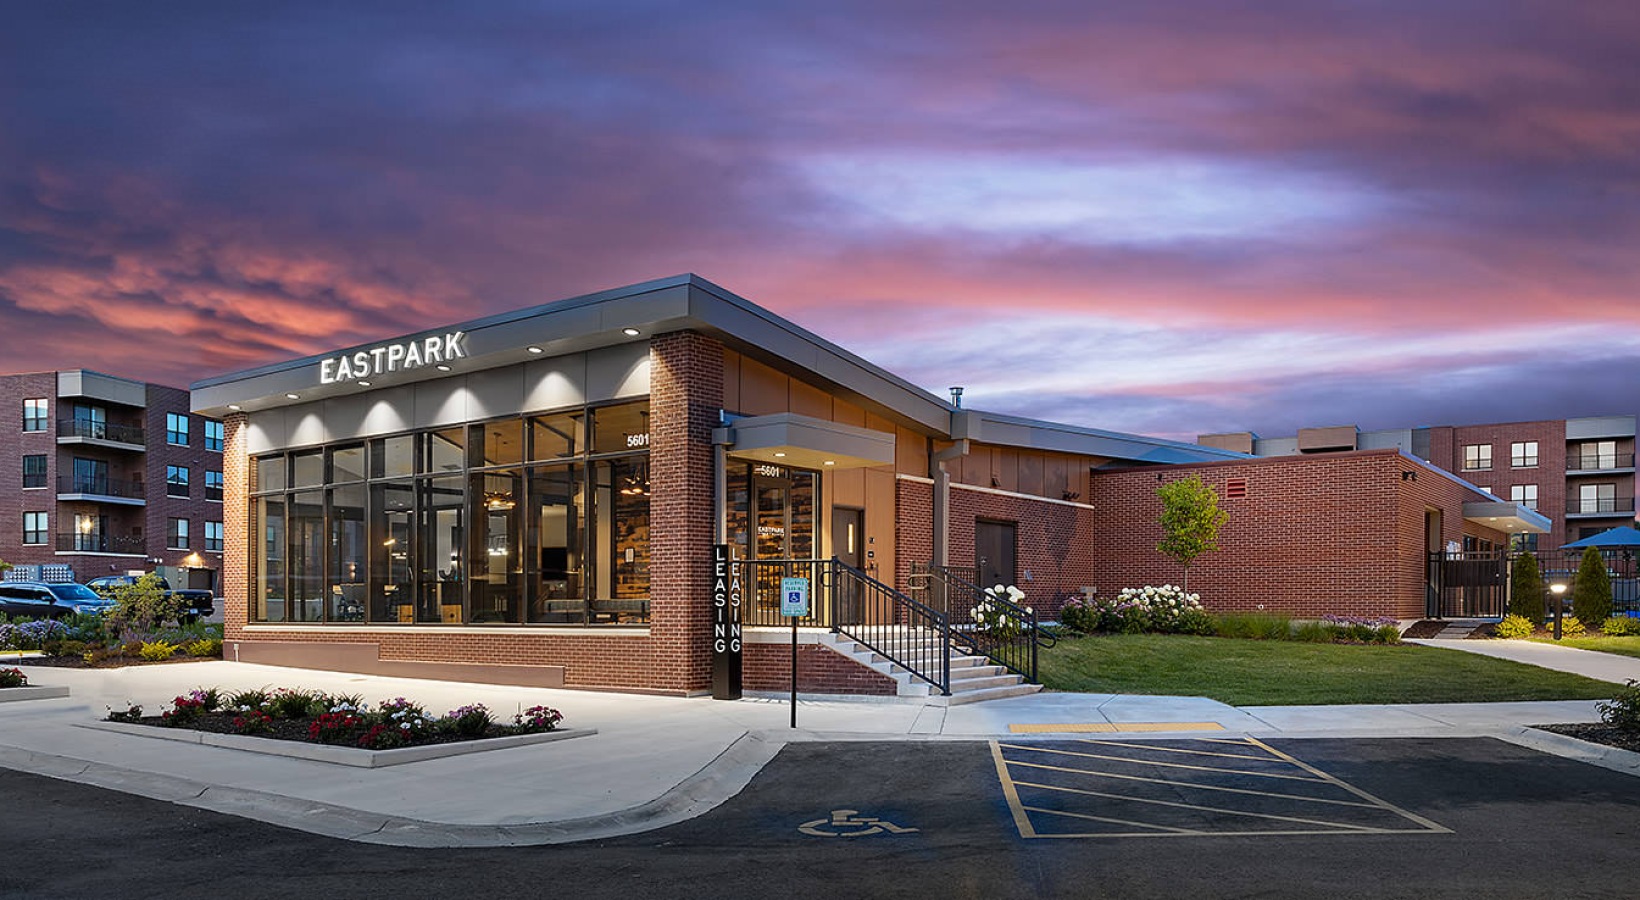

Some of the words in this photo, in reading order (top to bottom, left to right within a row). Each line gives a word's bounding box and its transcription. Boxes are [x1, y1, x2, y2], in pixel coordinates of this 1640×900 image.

[320, 331, 465, 384] EASTPARK
[627, 433, 650, 447] 5601
[760, 465, 780, 478] 5601
[715, 547, 726, 653] LEASING
[730, 547, 741, 653] LEASING
